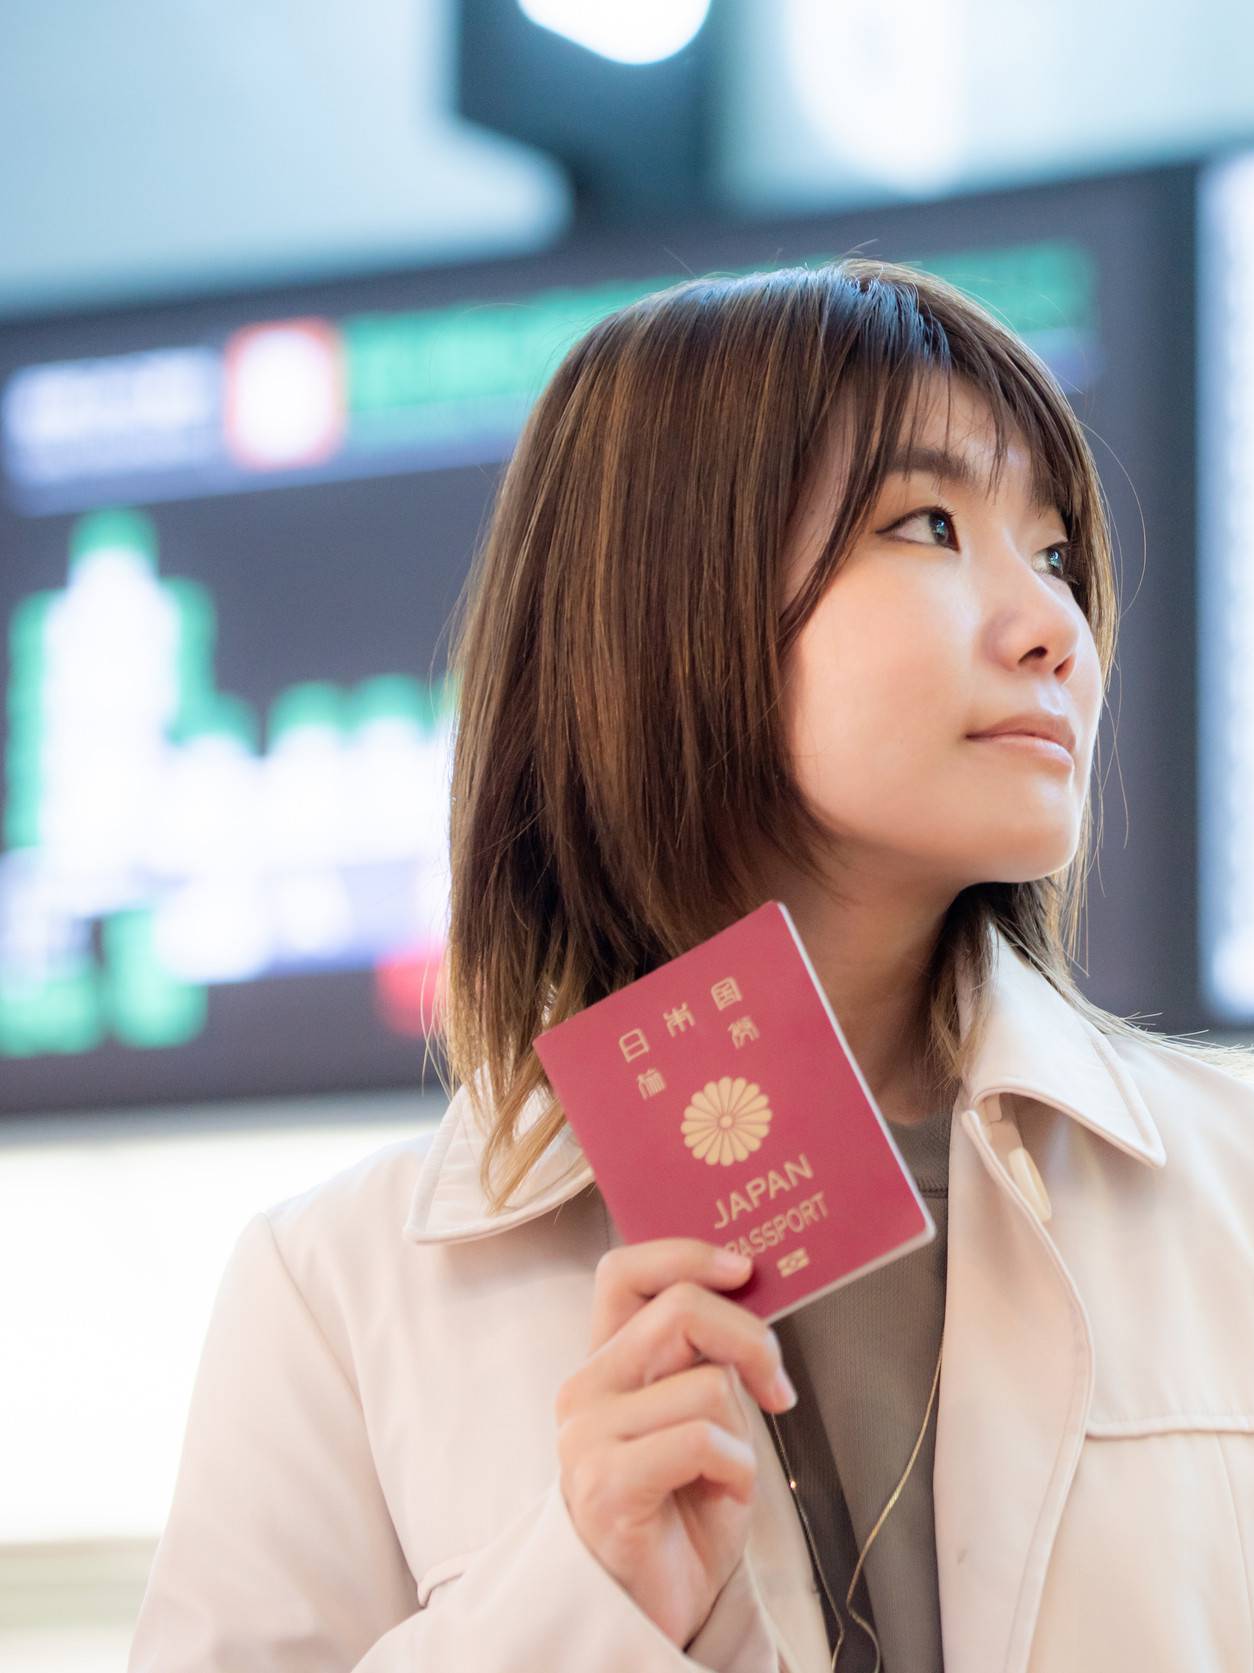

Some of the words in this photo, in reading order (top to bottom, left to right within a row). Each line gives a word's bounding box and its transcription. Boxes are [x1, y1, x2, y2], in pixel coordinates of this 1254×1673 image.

[618, 976, 743, 1063] 日本国
[714, 1152, 814, 1229] JAPAN
